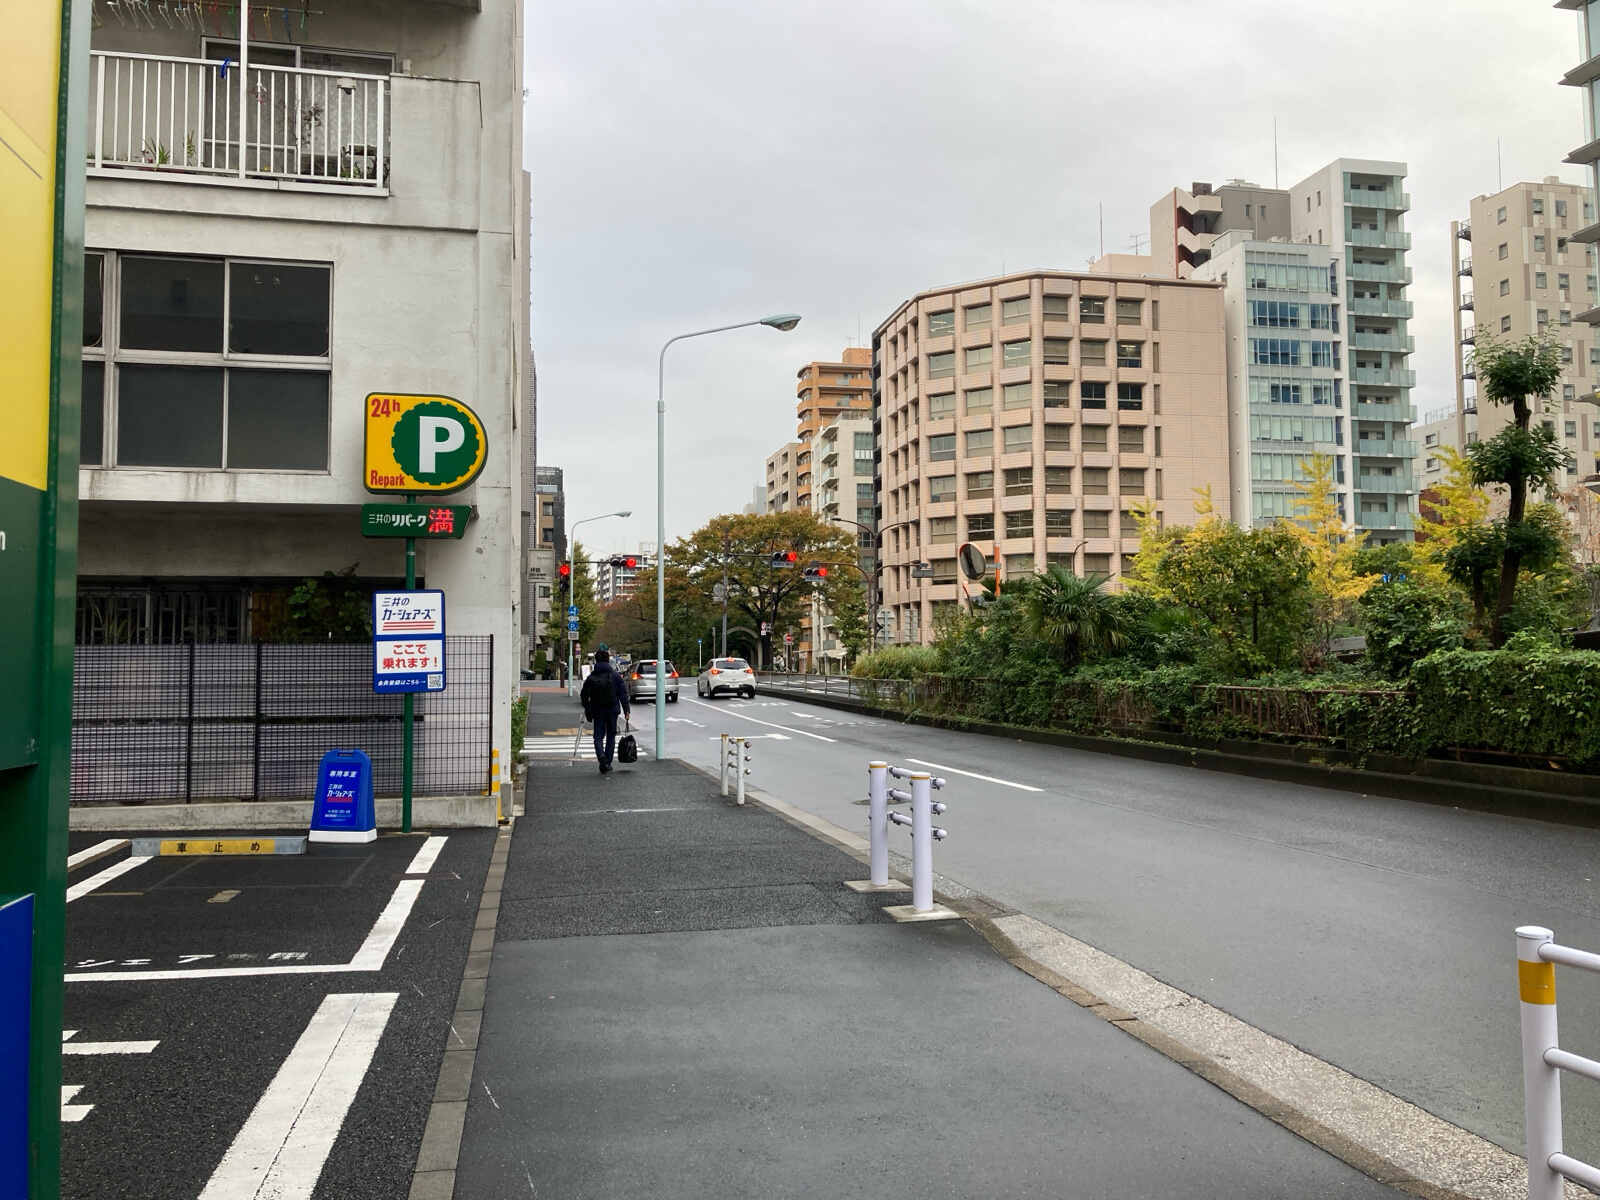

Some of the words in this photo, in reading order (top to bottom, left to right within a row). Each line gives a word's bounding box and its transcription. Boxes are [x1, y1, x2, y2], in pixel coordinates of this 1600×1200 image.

[371, 398, 401, 417] 24h
[419, 416, 465, 473] P
[370, 470, 405, 487] Repark
[368, 513, 426, 527] 三井のリパーク
[428, 508, 454, 533] 満
[382, 597, 409, 607] 三井の
[393, 644, 426, 655] ここで
[382, 656, 438, 670] 乗れます！
[176, 842, 261, 853] 車止め
